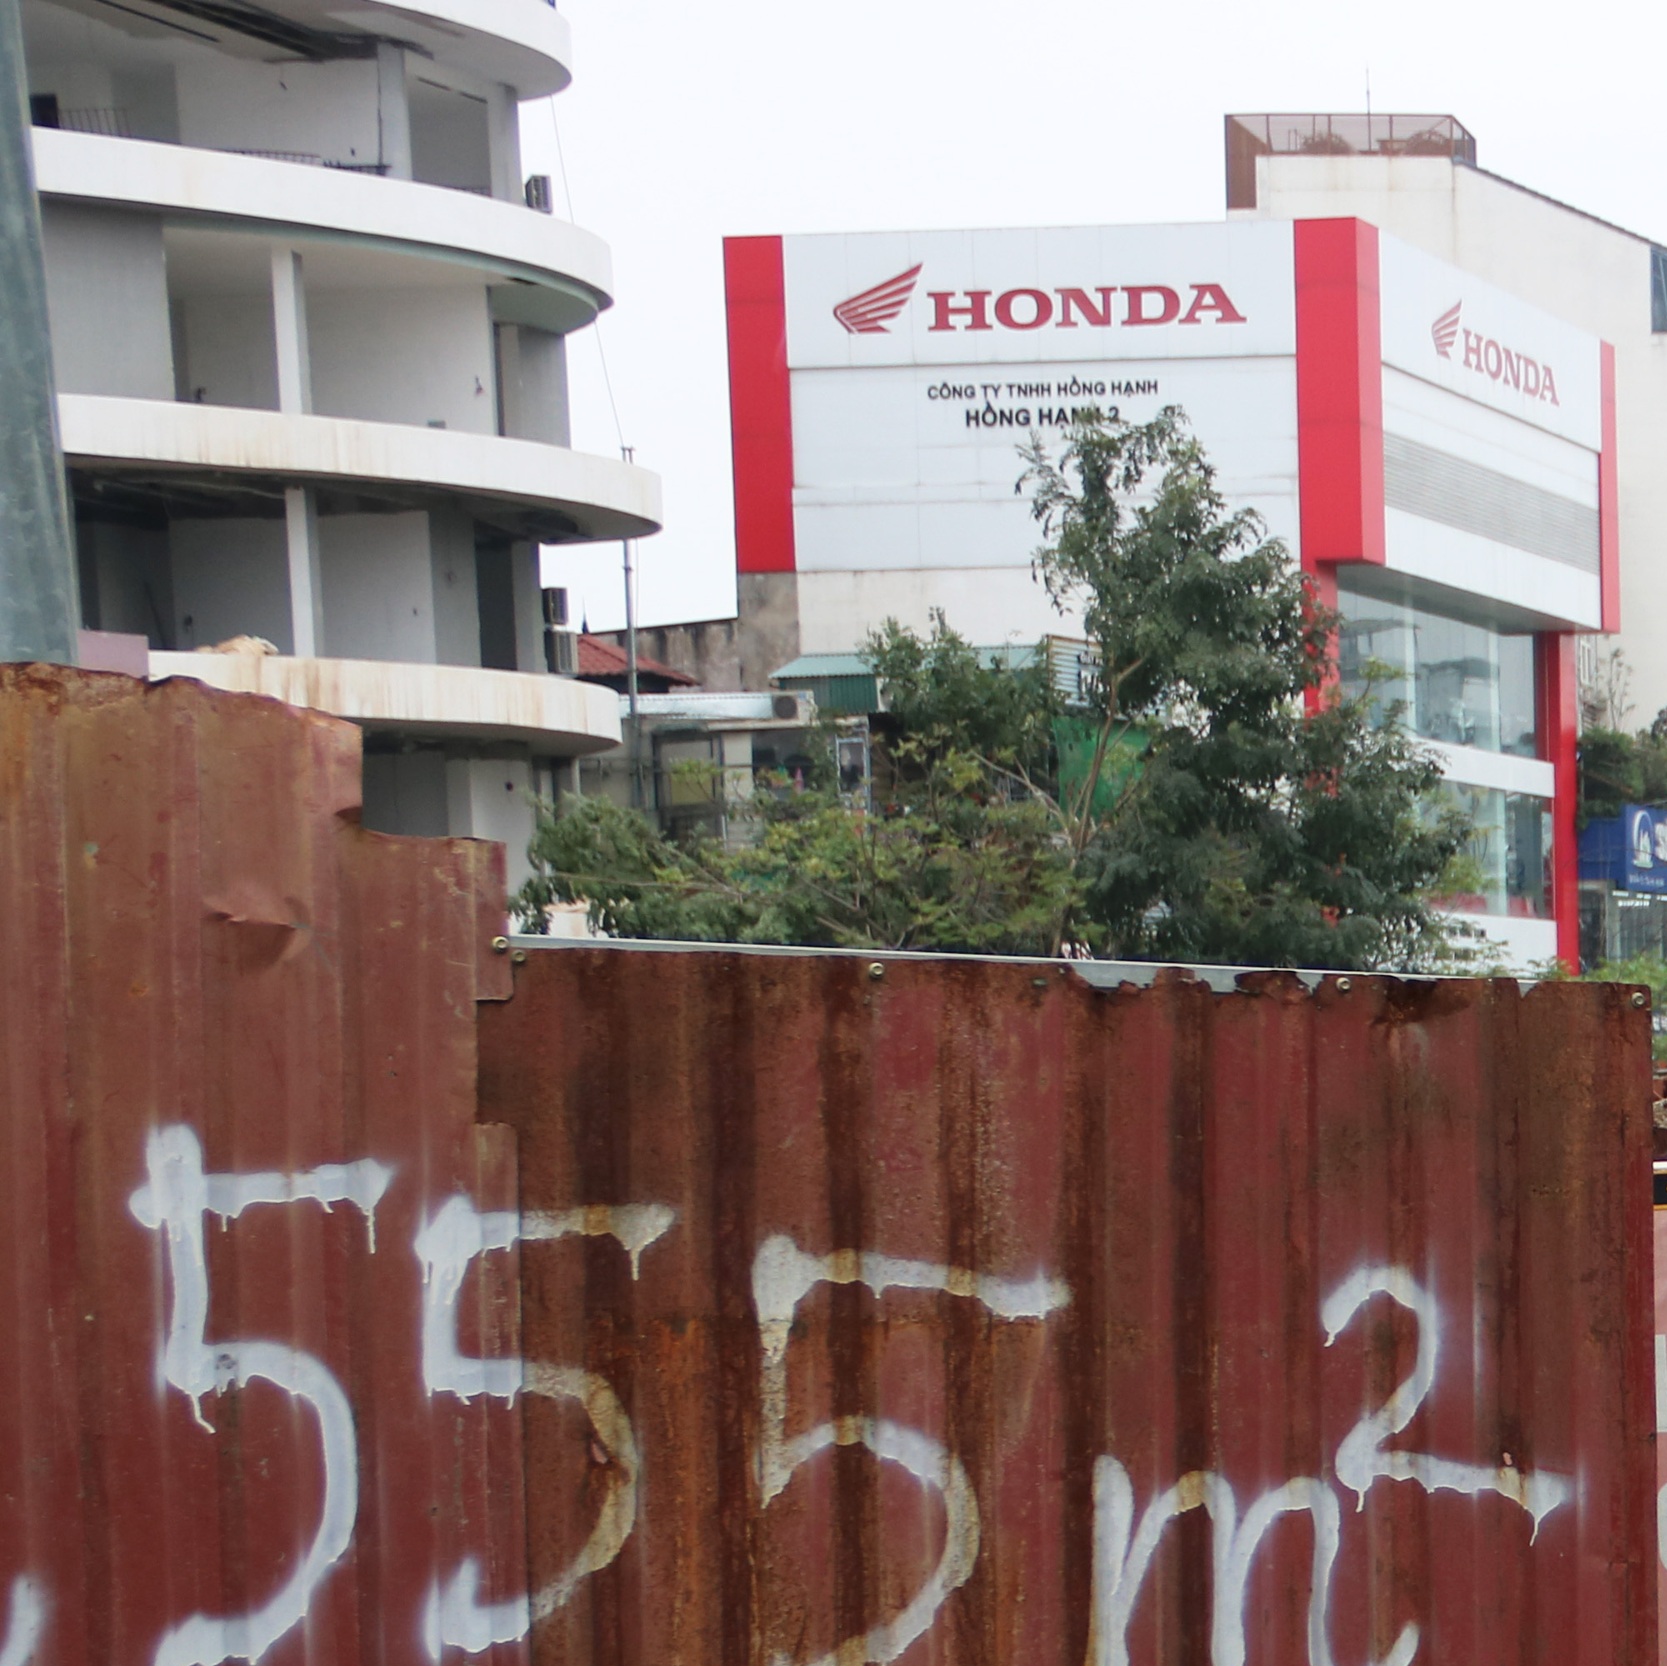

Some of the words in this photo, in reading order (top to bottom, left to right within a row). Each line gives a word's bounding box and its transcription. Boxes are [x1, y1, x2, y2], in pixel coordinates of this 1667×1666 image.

[926, 283, 1248, 332] HONDA
[1462, 327, 1560, 408] HONDA
[927, 381, 976, 400] CÔNG
[980, 384, 1001, 399] TY
[1006, 383, 1052, 398] TNHH
[1057, 375, 1106, 398] HỒNG
[1111, 379, 1159, 399] HẠNH
[965, 401, 1031, 428] HỒNG
